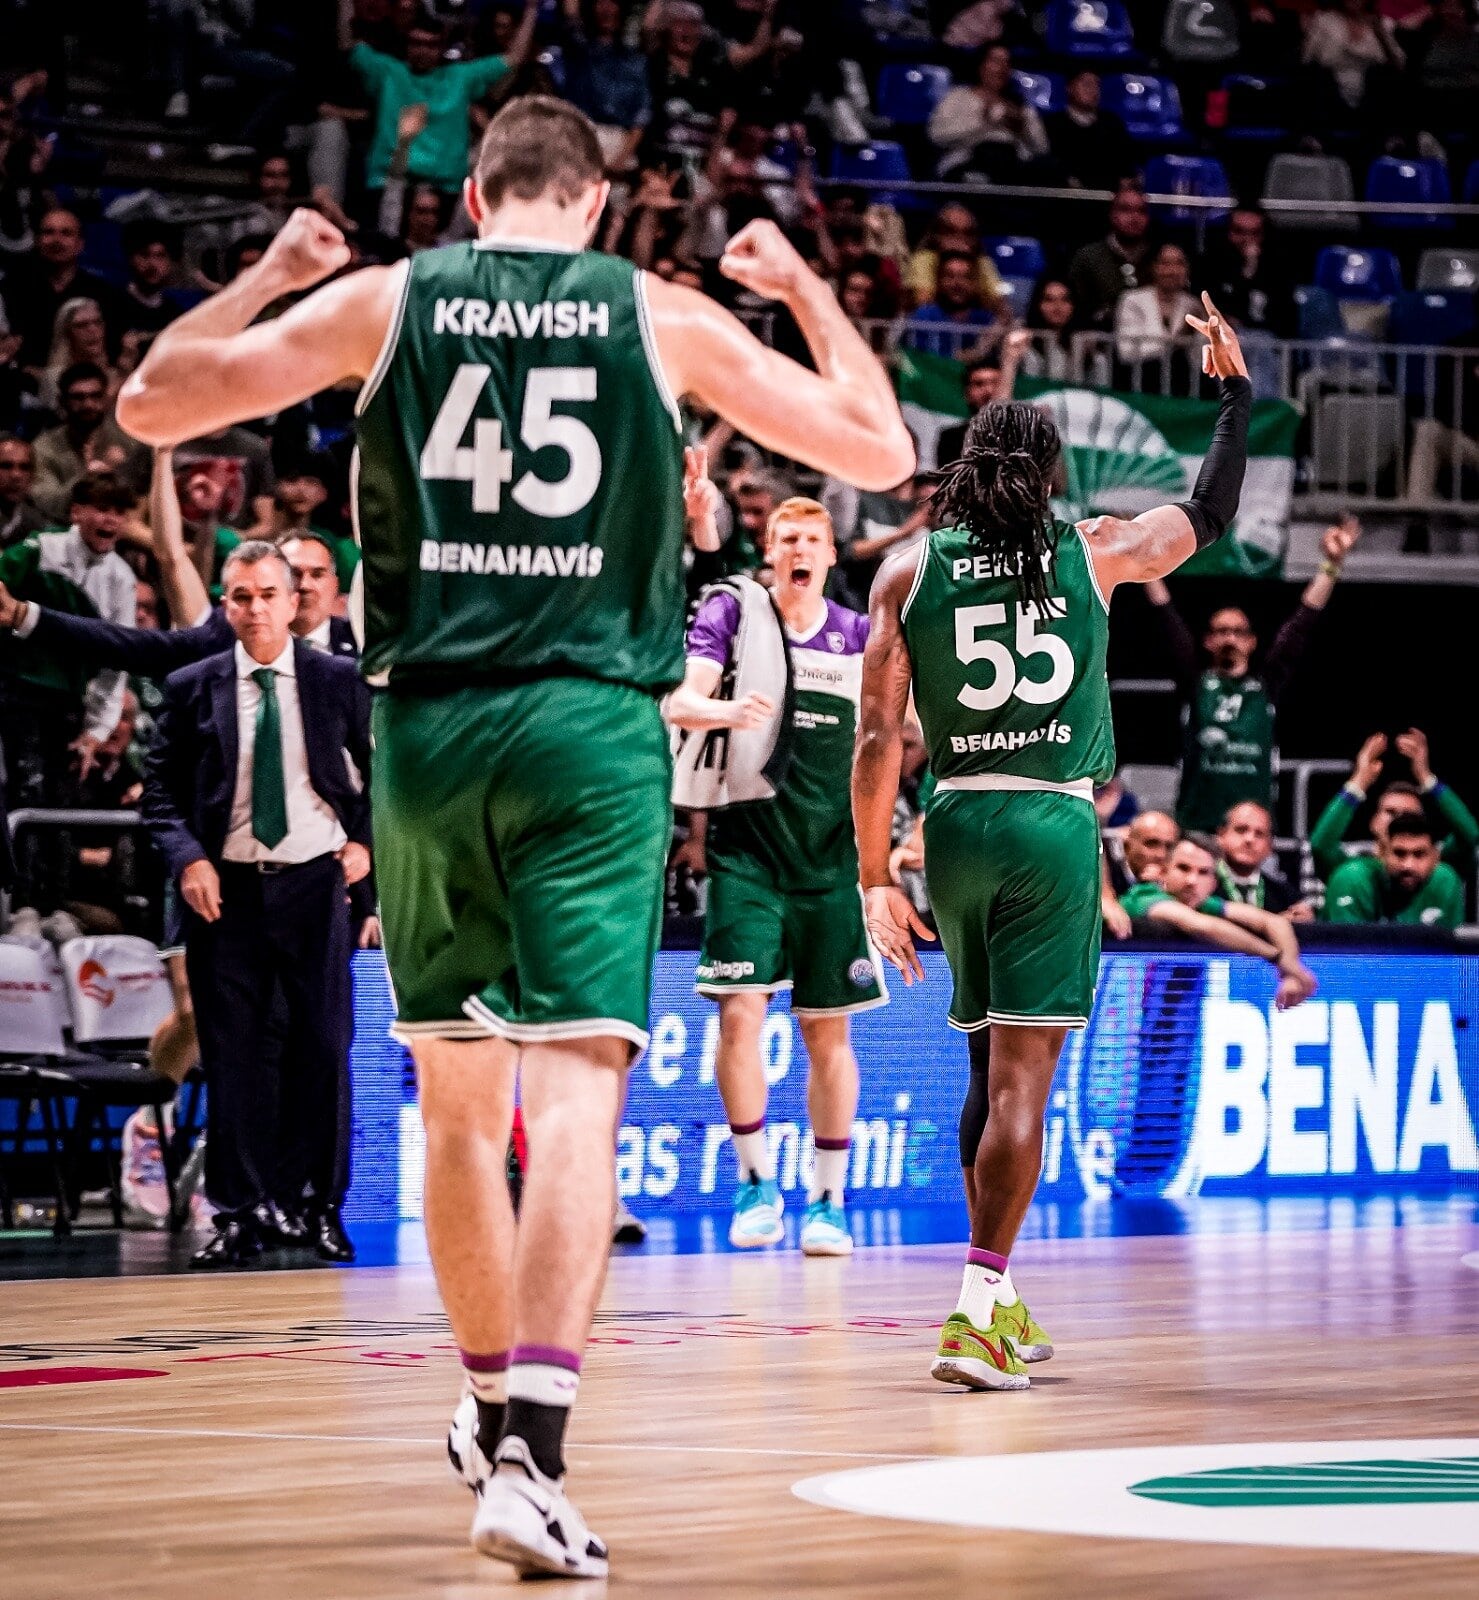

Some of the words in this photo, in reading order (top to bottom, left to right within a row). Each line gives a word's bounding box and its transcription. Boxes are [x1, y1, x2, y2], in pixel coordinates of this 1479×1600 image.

[432, 297, 610, 339] KRAVISH
[420, 363, 602, 518] 45
[419, 539, 604, 577] BENAHAVÍS
[955, 597, 1075, 711] 55
[1199, 1000, 1479, 1177] BENA
